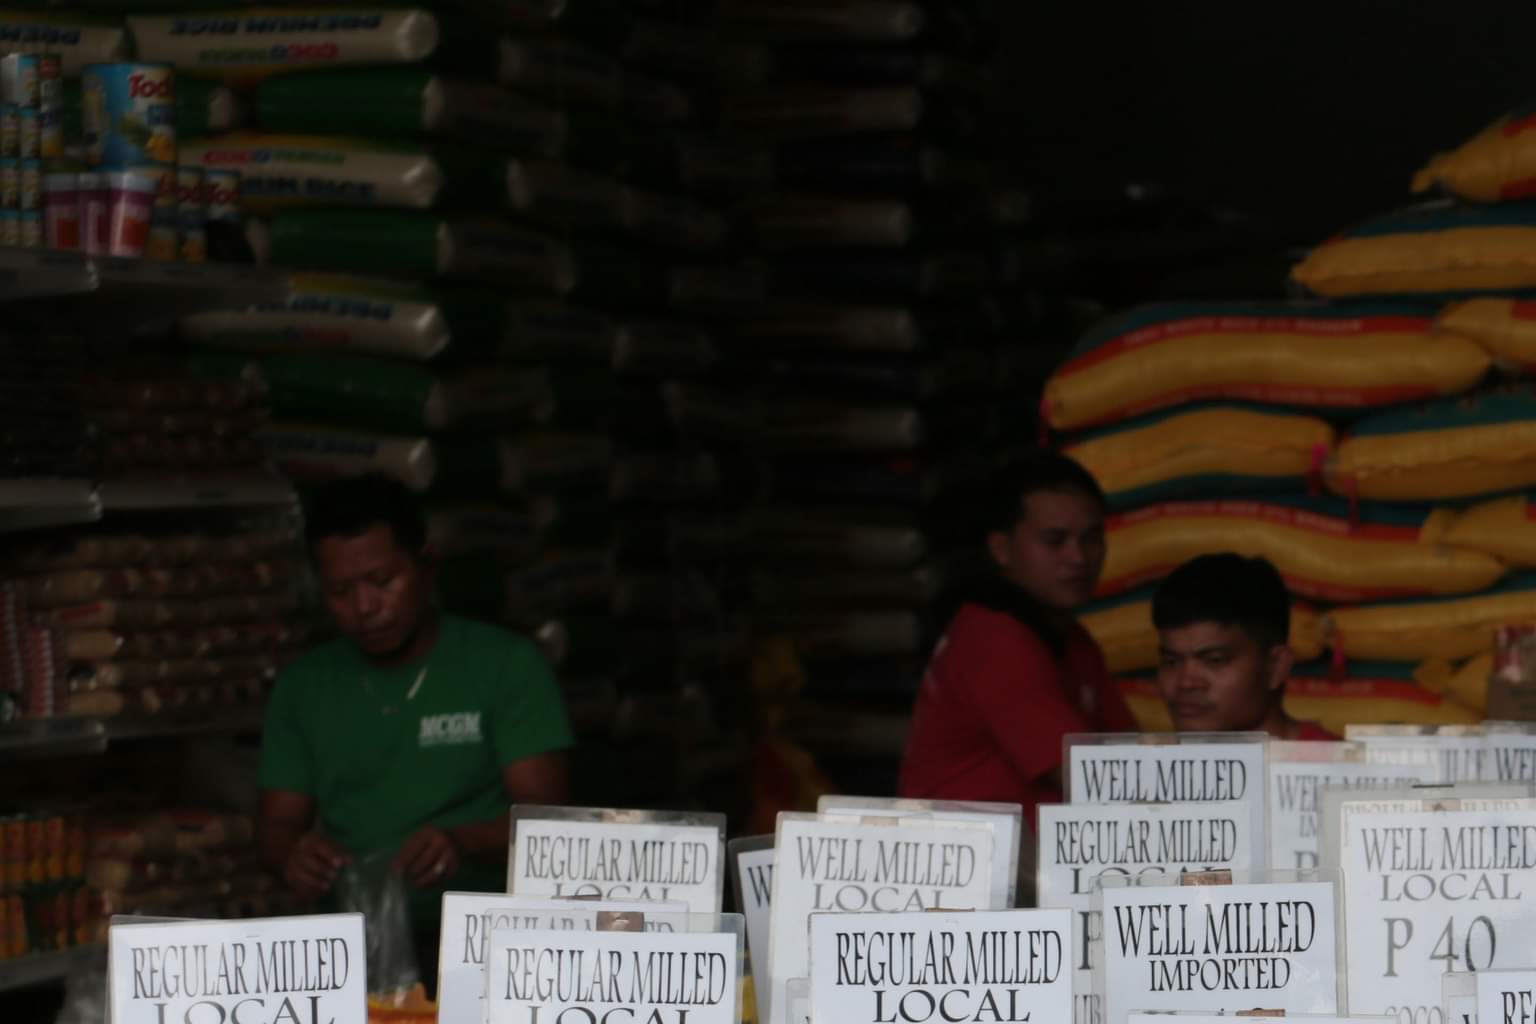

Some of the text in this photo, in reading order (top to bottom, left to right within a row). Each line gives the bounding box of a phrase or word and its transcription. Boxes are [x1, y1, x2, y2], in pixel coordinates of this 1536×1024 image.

[1081, 759, 1246, 802] WELL MILLED
[525, 836, 709, 885] REGULAR MILLED
[798, 836, 975, 888] WELL MILLED
[1056, 819, 1236, 865] REGULAR MILLED
[1362, 828, 1435, 872] WELL
[814, 885, 942, 912] LOCAL
[1381, 873, 1521, 901] LOCAL
[1114, 901, 1315, 957] WELL MILLED
[1383, 916, 1496, 977] P 40
[132, 938, 349, 1000] REGULAR MILLED
[505, 948, 726, 1006] REGULAR MILLED
[837, 930, 1062, 986] REGULAR MILLED
[1149, 958, 1290, 992] IMPORTED
[874, 989, 1030, 1023] LOCAL
